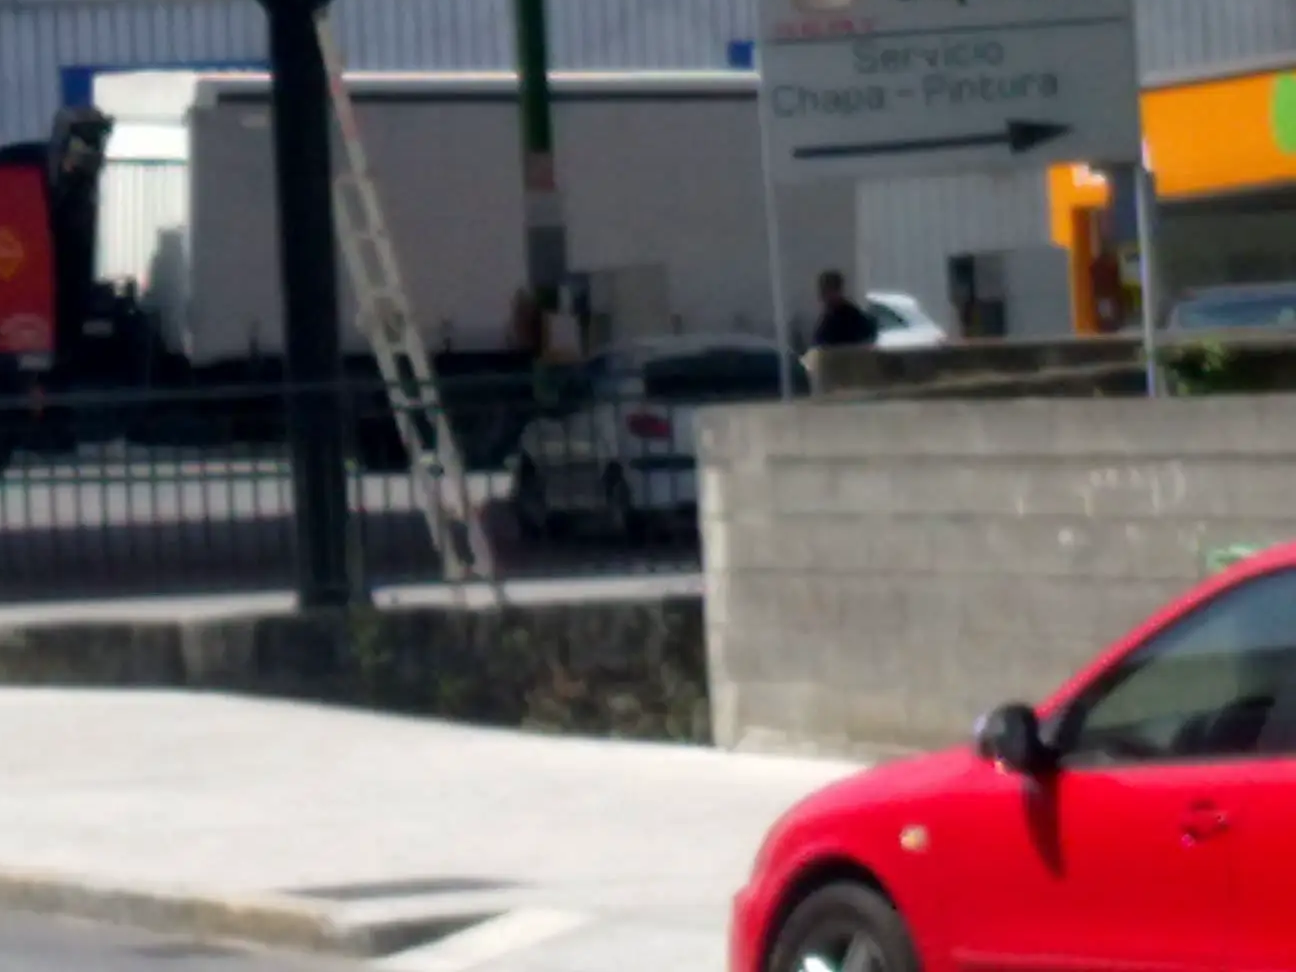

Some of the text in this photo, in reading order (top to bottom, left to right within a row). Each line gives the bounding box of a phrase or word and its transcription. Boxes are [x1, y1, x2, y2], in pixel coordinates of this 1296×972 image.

[852, 36, 1004, 74] Servicio
[771, 84, 885, 117] Chapa
[921, 71, 1059, 106] Pintura
